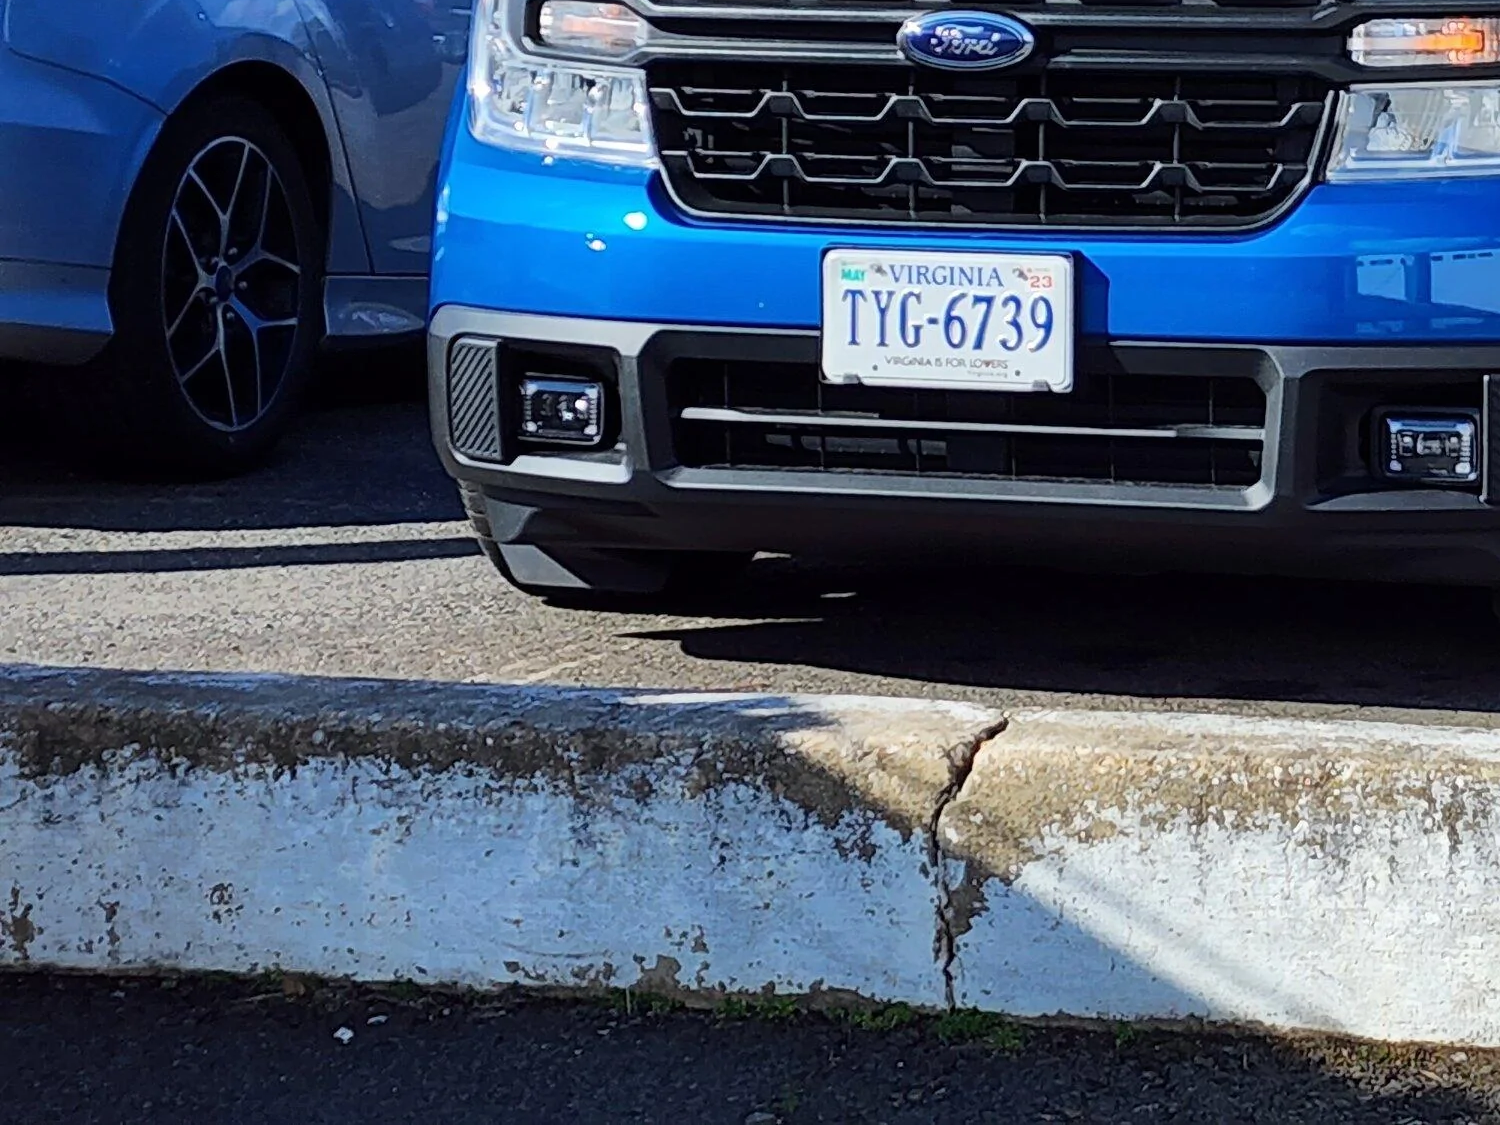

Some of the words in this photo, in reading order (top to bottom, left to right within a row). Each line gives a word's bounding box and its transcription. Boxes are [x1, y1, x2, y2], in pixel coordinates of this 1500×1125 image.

[930, 23, 1001, 55] Ford
[889, 264, 1004, 288] VIRGINIA
[1030, 275, 1053, 288] 23
[841, 289, 1054, 353] TYG-6739
[885, 355, 932, 367] VIRGINIA
[945, 358, 966, 368] FOR
